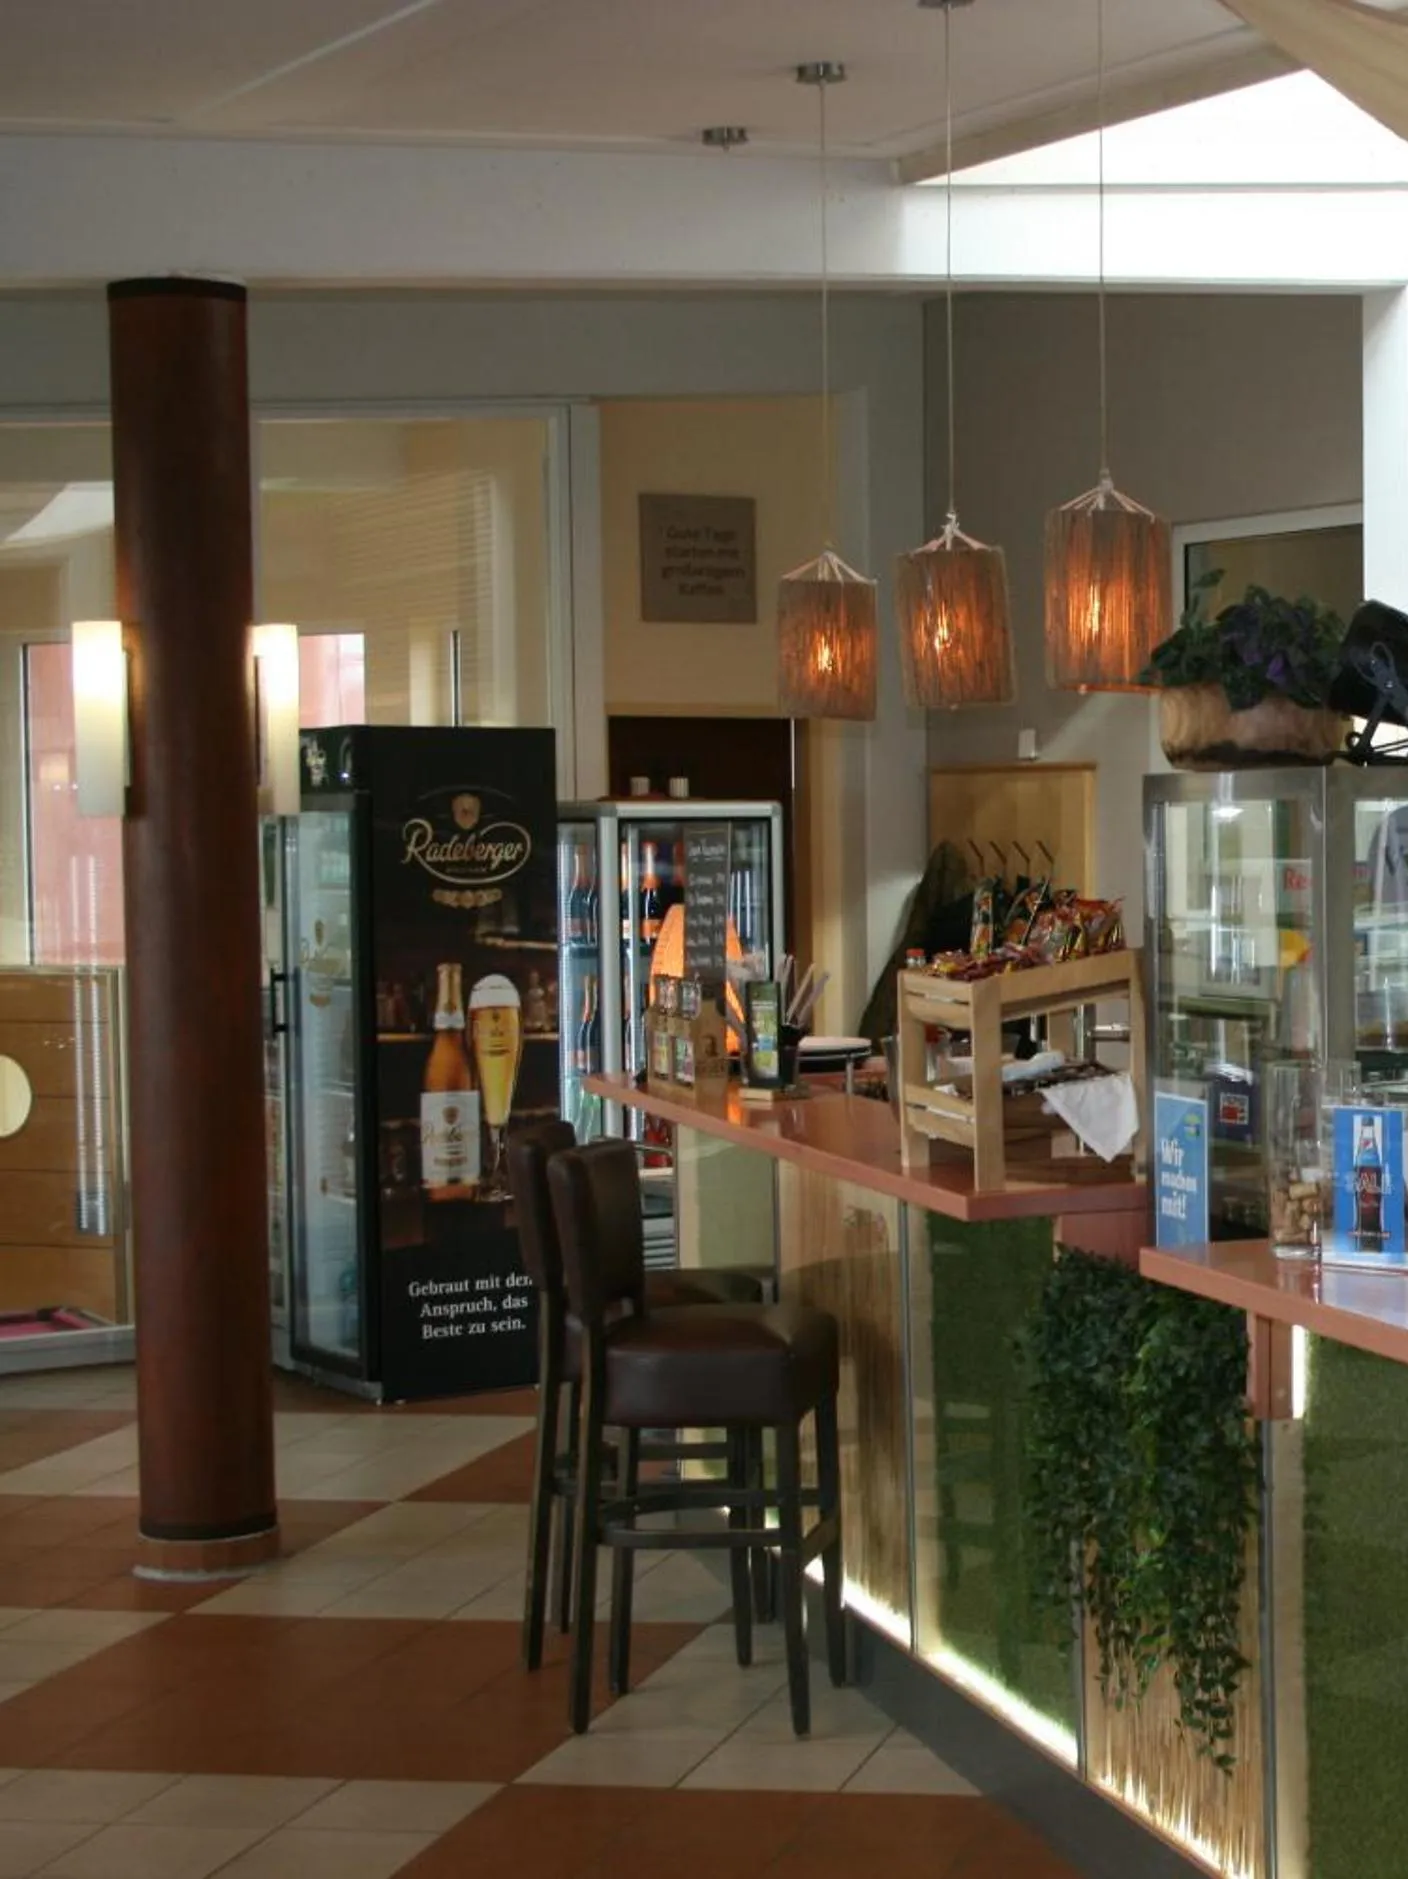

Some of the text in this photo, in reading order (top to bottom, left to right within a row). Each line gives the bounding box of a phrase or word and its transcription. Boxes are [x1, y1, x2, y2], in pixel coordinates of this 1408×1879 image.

[401, 818, 528, 877] Radeberger
[1160, 1138, 1185, 1167] Wir
[1160, 1170, 1197, 1192] machen
[1160, 1191, 1187, 1221] mit!
[408, 1280, 469, 1297] Gebraut
[475, 1273, 500, 1290] mit
[502, 1294, 529, 1309] das
[422, 1316, 527, 1340] Beste zu sein.
